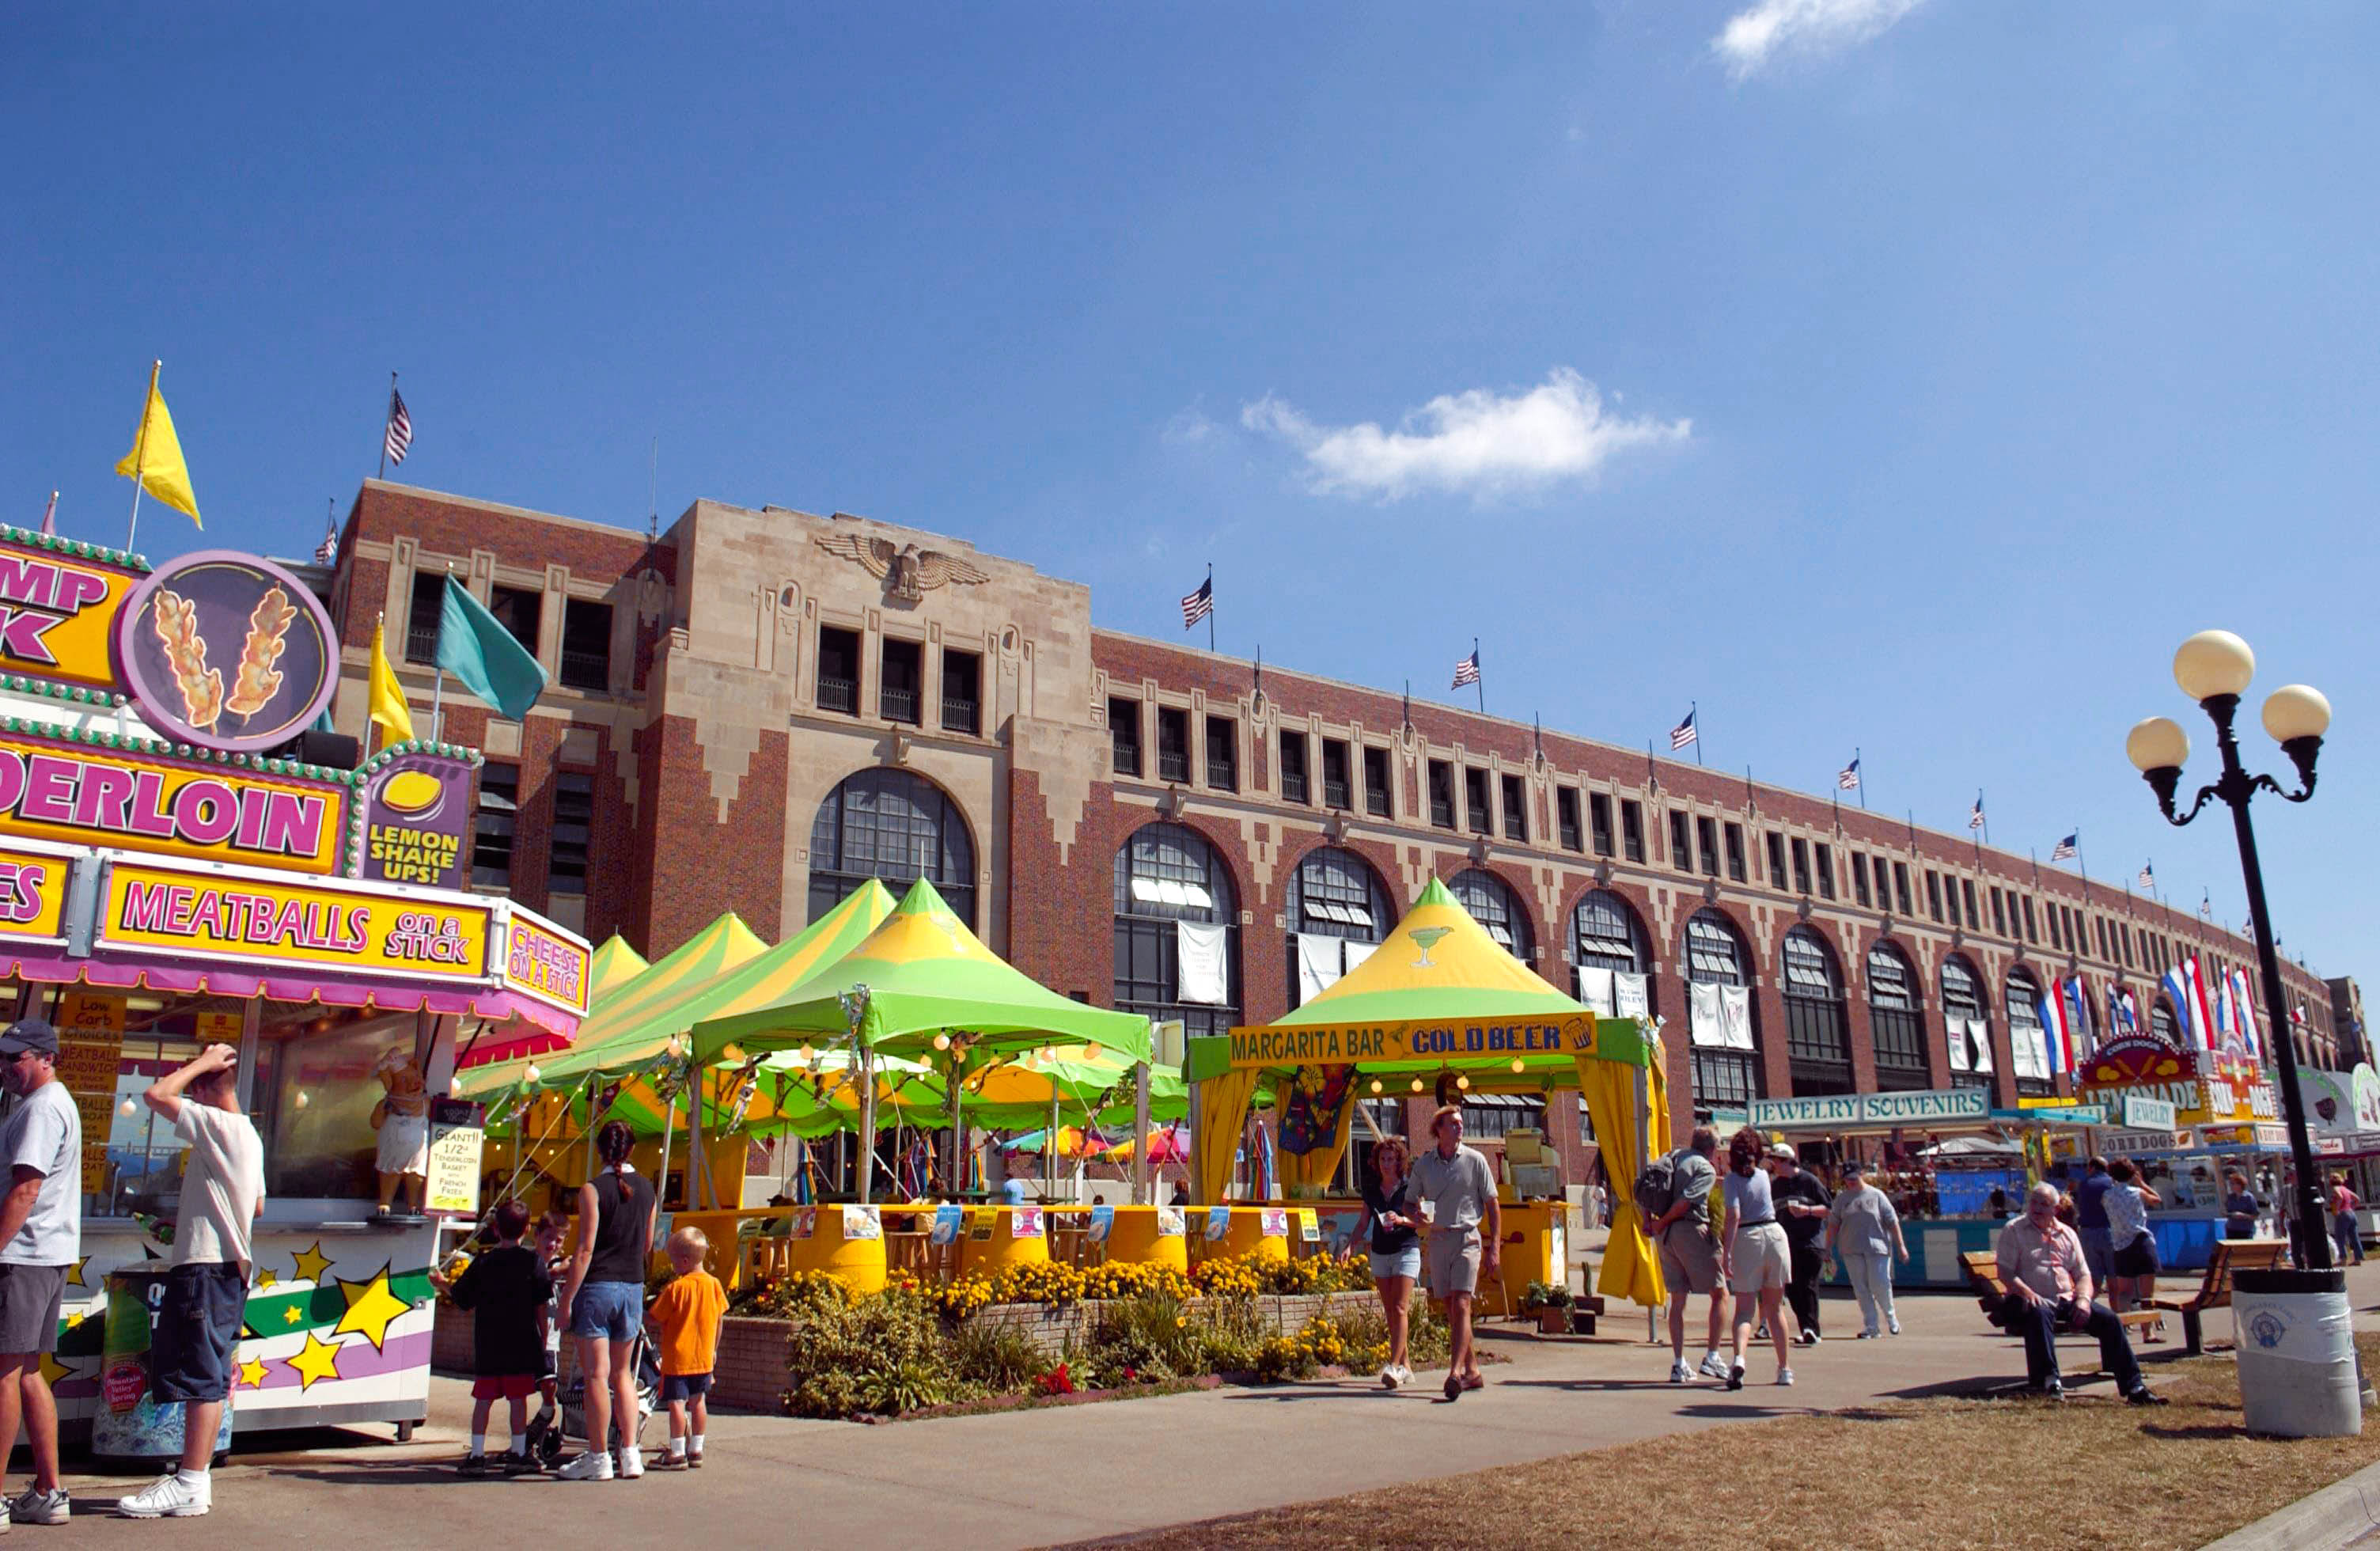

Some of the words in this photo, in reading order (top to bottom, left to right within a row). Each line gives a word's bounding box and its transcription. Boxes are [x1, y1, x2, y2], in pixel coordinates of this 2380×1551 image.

[370, 824, 459, 851] LEMON
[370, 842, 457, 869] SHAKE
[384, 863, 440, 885] UPS!
[121, 881, 370, 954] MEATBALLS
[398, 912, 437, 935] on
[442, 916, 461, 937] a
[385, 931, 470, 965] STICK
[511, 923, 581, 975] CHEESE
[509, 950, 530, 981] ON
[534, 961, 544, 989] A
[547, 965, 579, 1002] STICK
[81, 998, 109, 1011] Low
[75, 1012, 112, 1026] Carb
[59, 1046, 120, 1062] MEATBALL
[1230, 1030, 1340, 1062] MARGARITA
[1347, 1028, 1385, 1057] BAR
[1412, 1023, 1485, 1054] COLD
[1488, 1019, 1561, 1051] BEER
[56, 1063, 119, 1074] SANDWICH
[1753, 1098, 1856, 1124] JEWELRY
[1866, 1092, 1984, 1118] SOUVENIRS
[2132, 1101, 2170, 1124] JEWELRY
